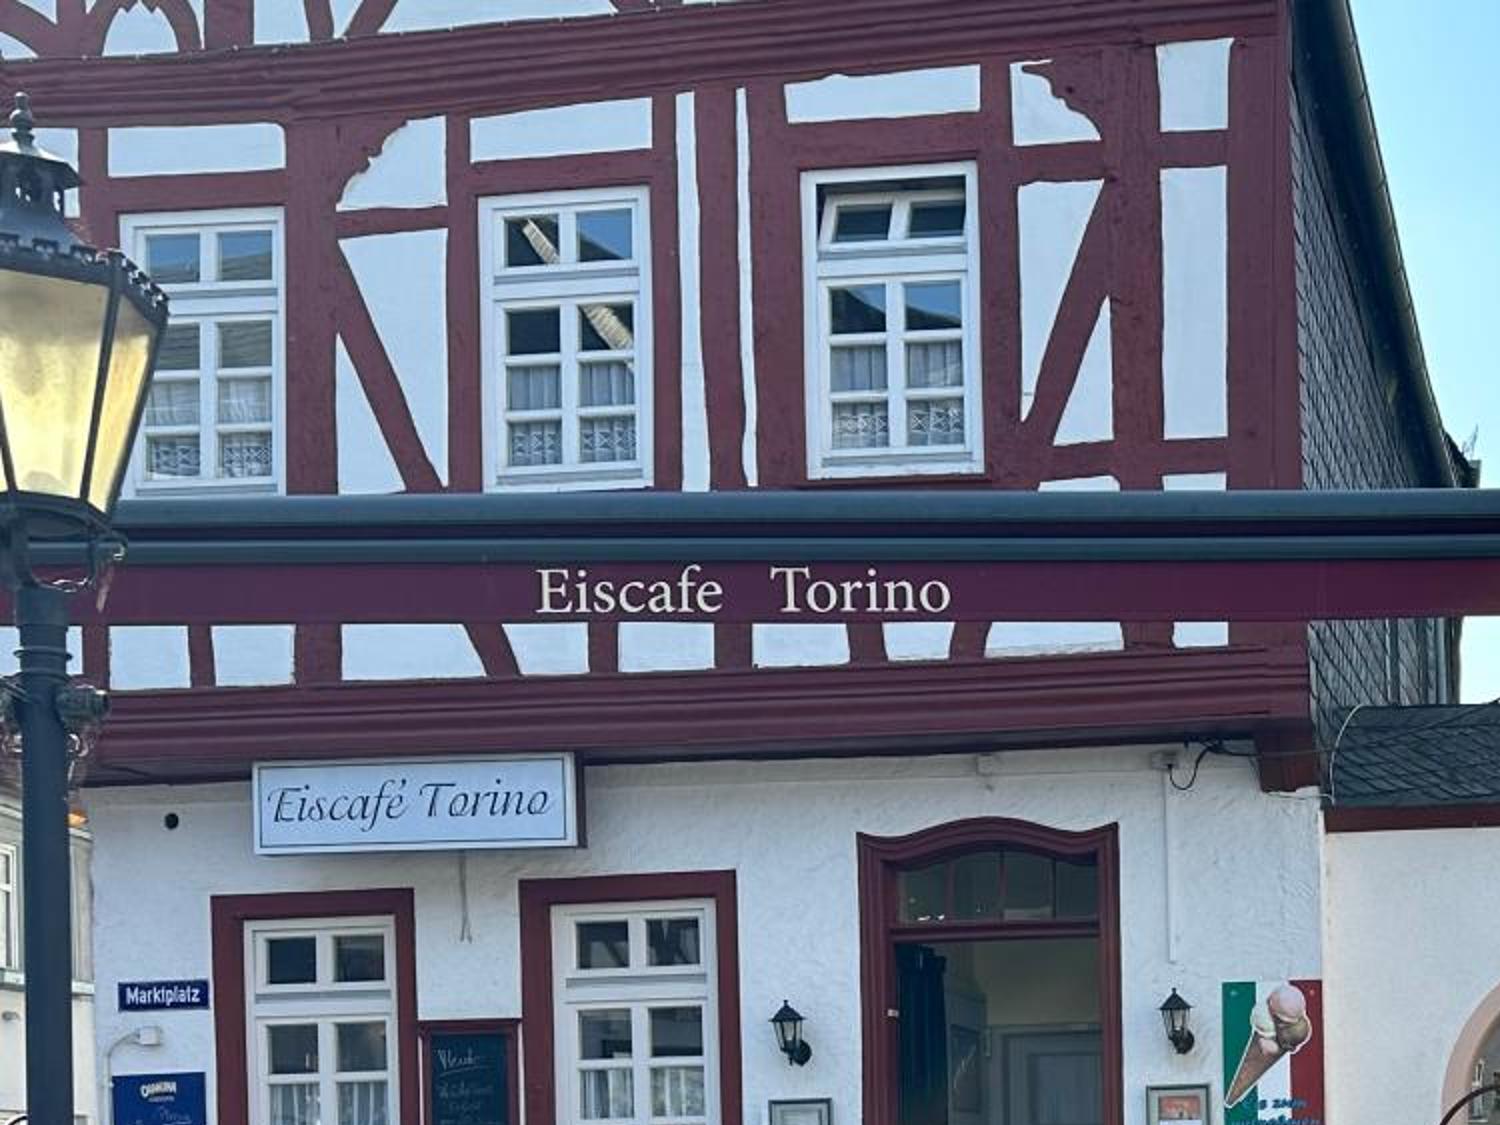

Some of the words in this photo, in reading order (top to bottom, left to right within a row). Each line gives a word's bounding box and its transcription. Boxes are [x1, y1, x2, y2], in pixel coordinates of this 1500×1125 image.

[536, 565, 723, 614] Eiscafe
[770, 566, 951, 613] Torino
[267, 778, 409, 832] Eiscafé
[419, 778, 552, 818] Torino
[125, 985, 201, 1007] Marktplatz
